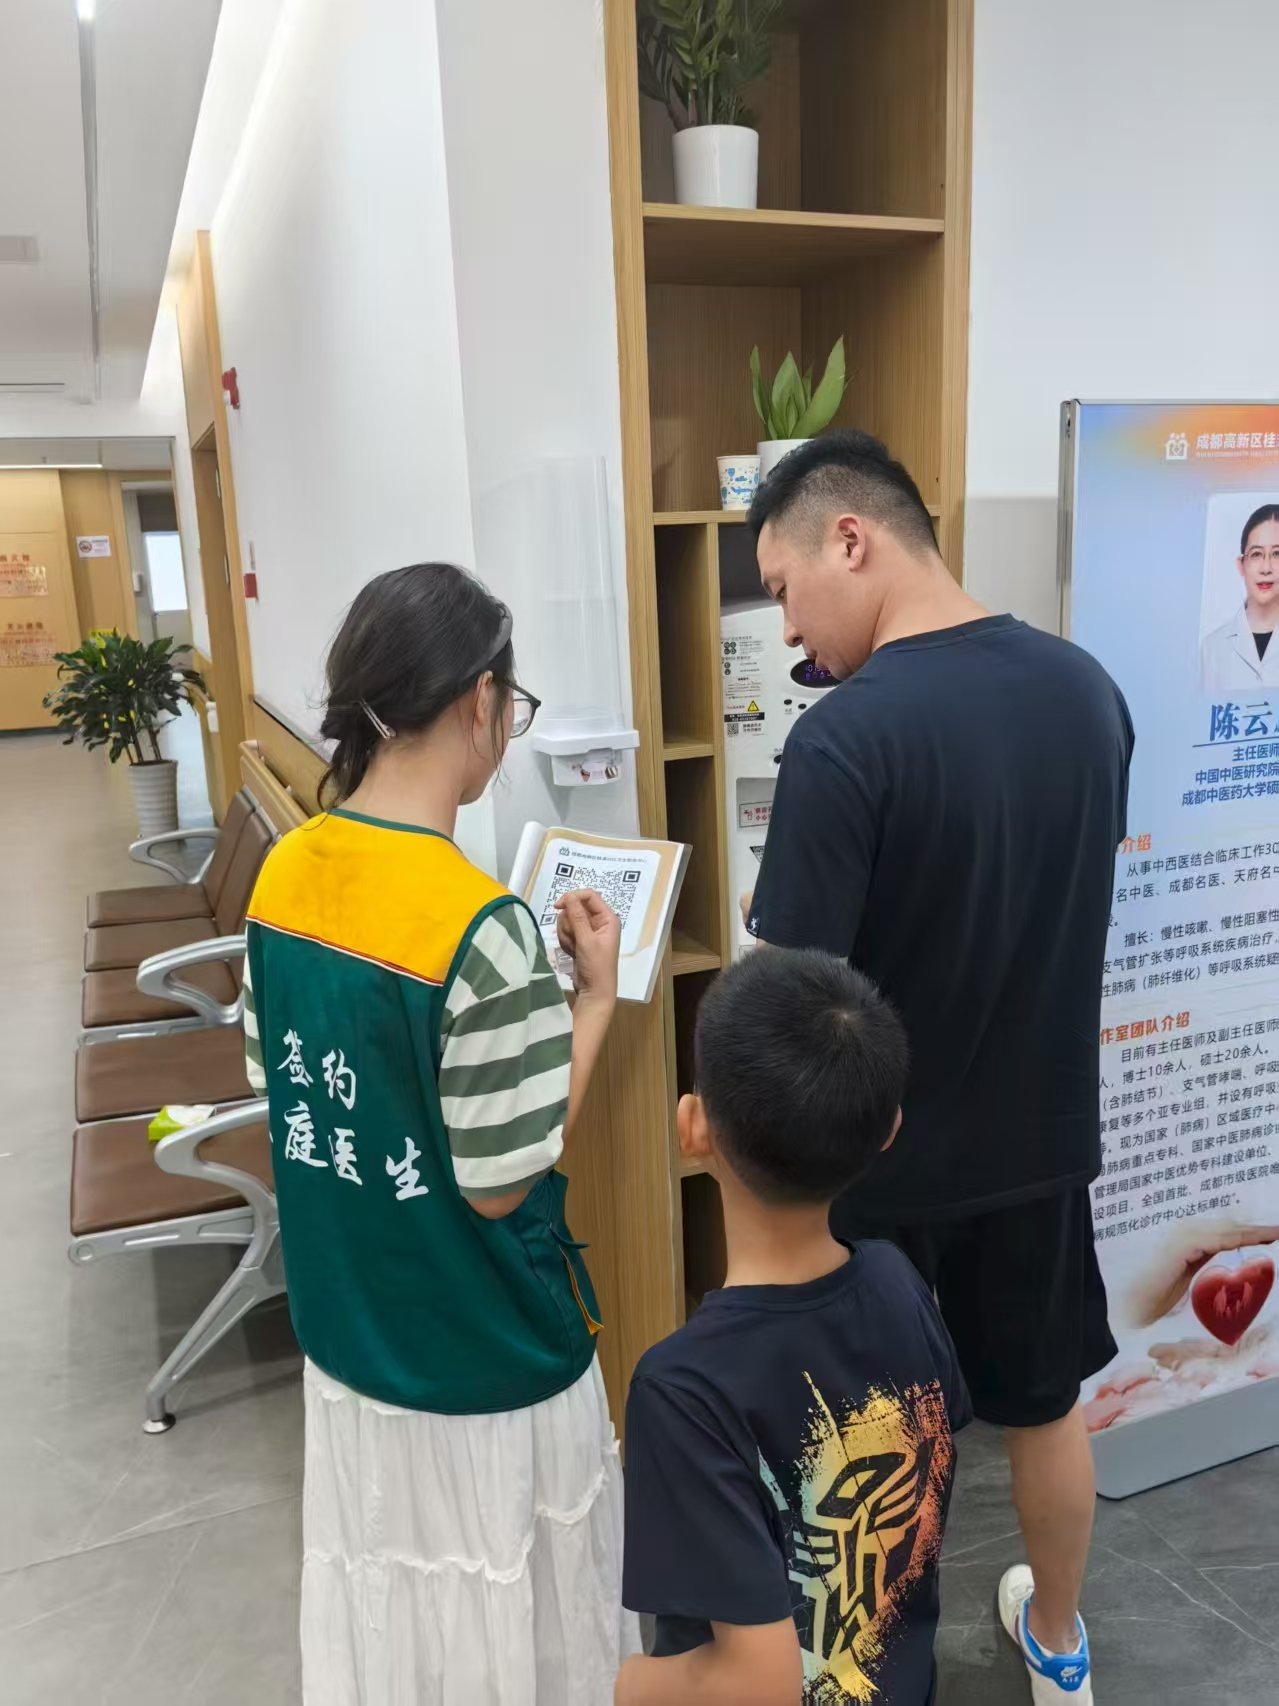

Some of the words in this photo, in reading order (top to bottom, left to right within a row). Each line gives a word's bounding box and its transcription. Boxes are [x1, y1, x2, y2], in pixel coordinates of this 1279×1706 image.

[1196, 432, 1279, 449] 成都高新区桂
[1209, 701, 1279, 742] 陈云
[277, 1029, 356, 1110] 签约
[270, 1100, 429, 1201] 庭医生
